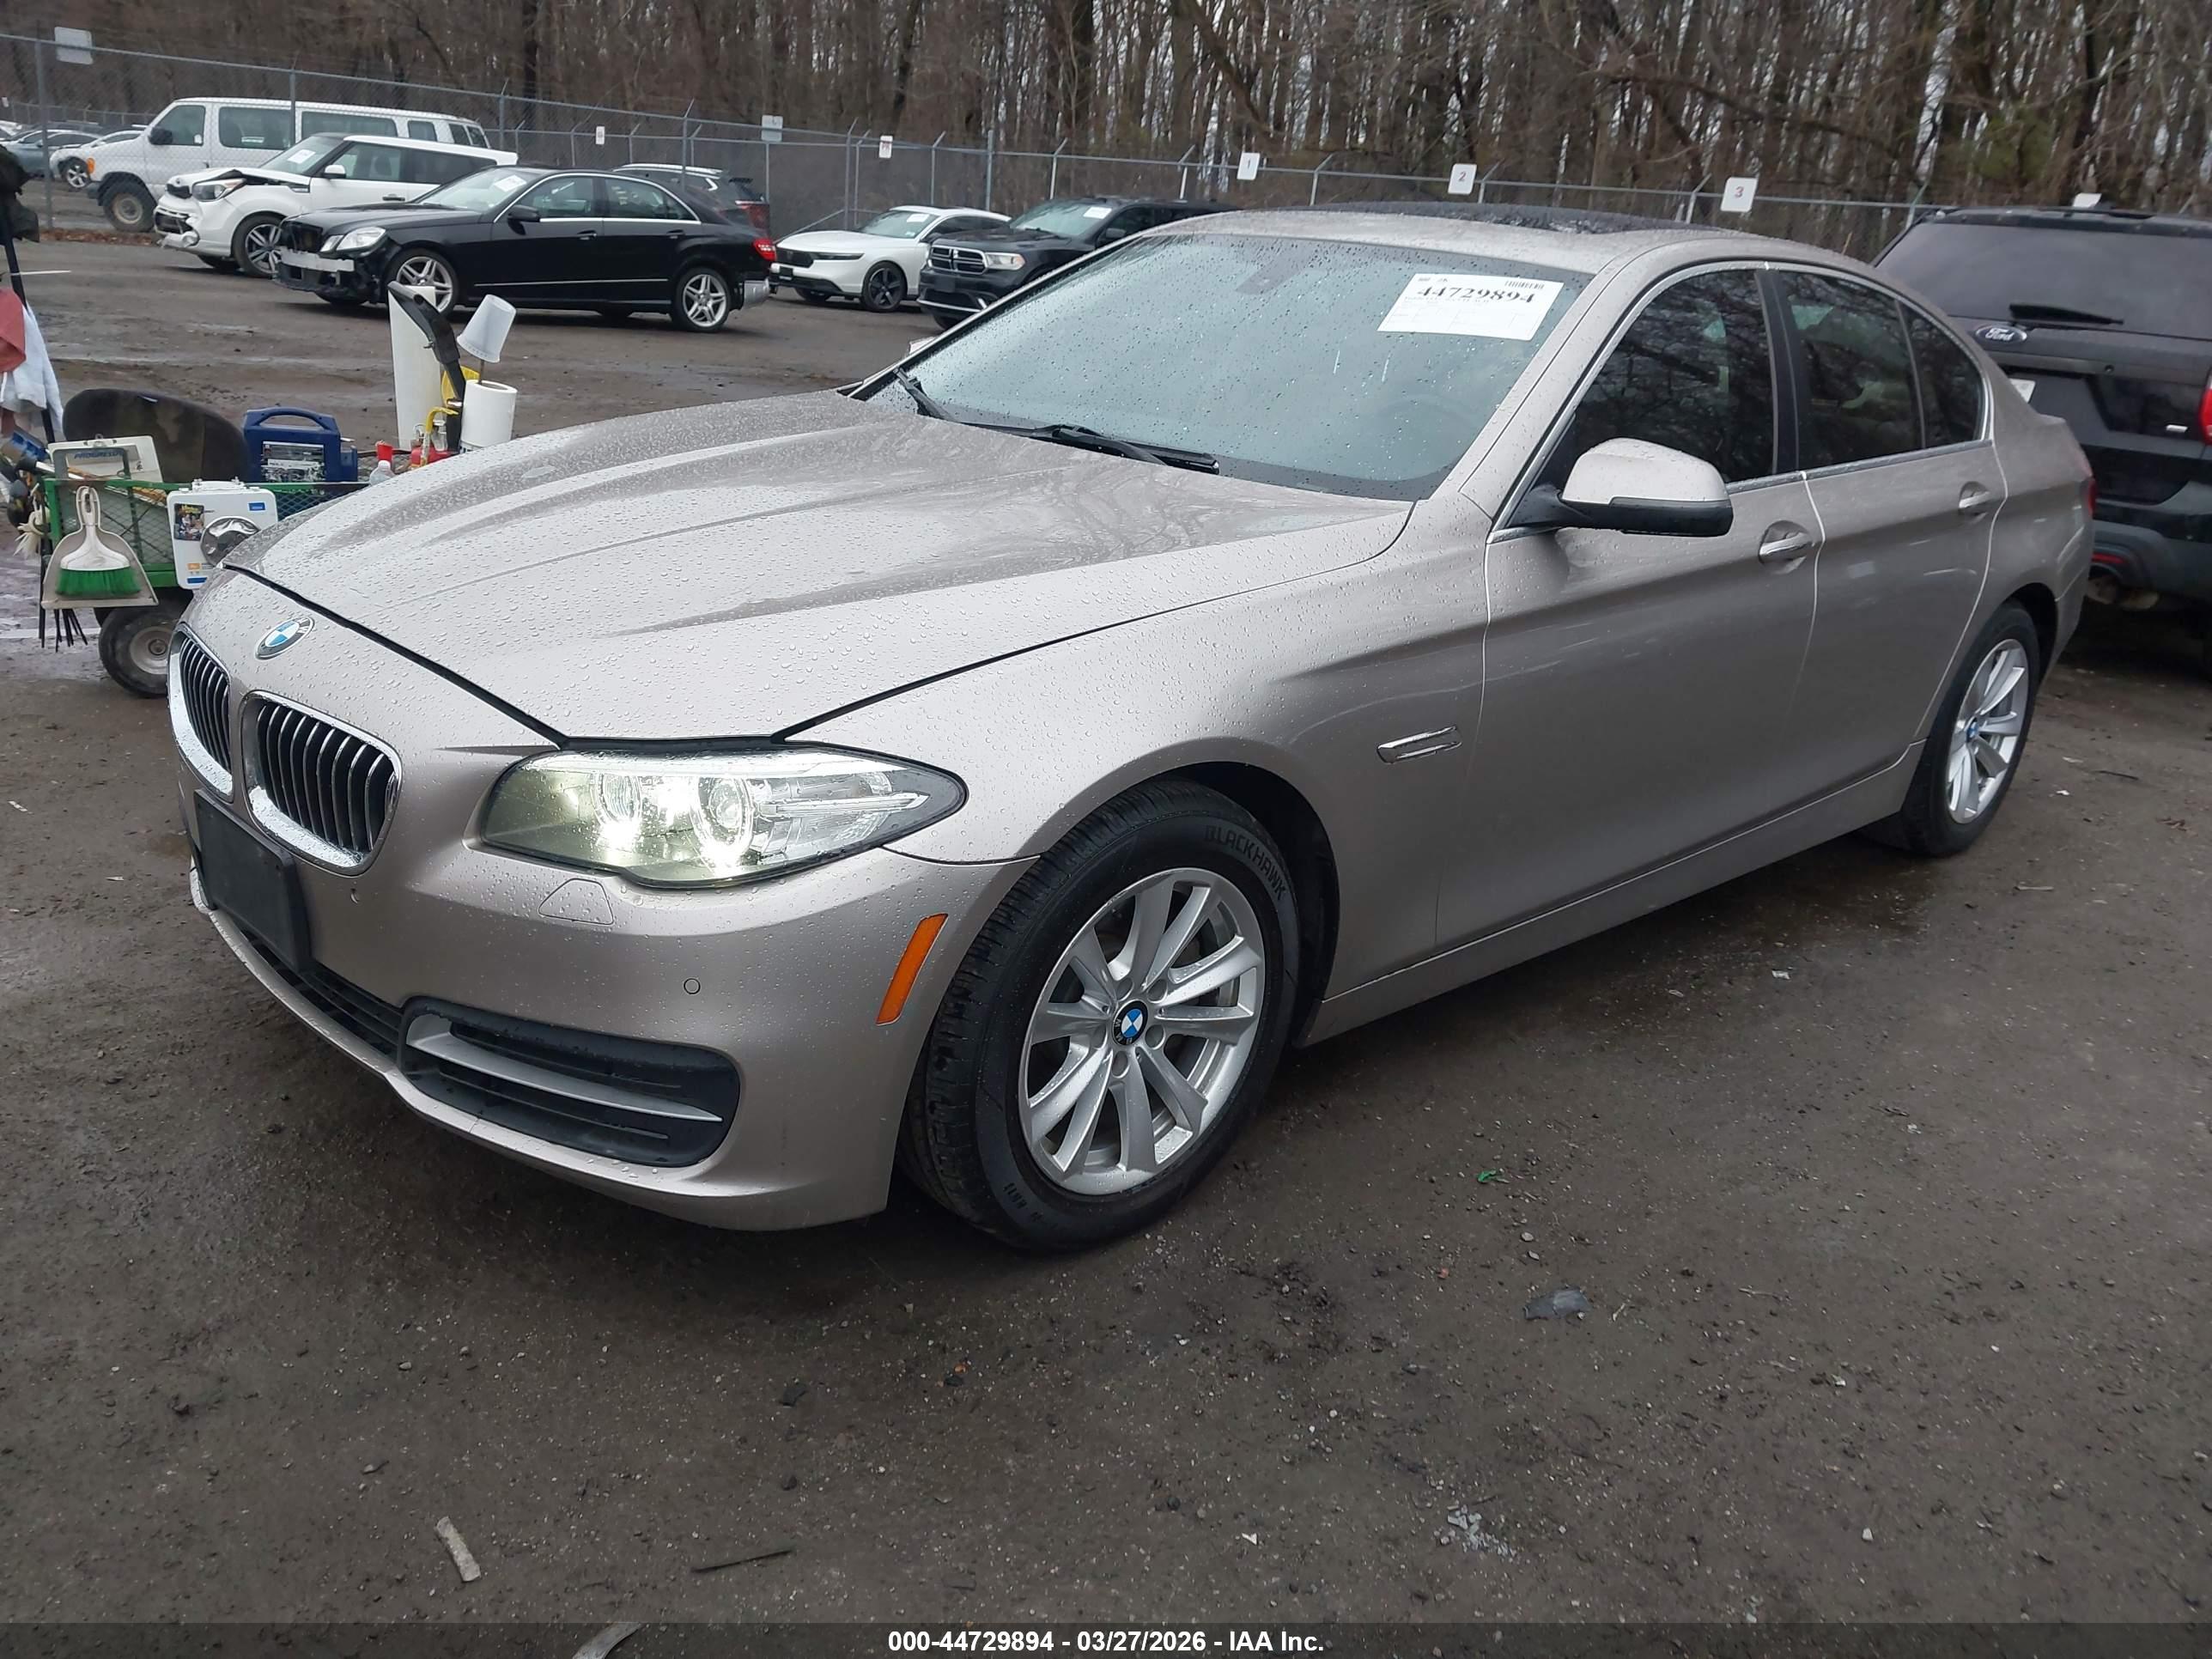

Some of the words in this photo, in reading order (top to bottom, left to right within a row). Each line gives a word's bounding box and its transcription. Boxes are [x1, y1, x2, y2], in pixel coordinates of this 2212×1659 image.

[1459, 171, 1467, 181] 2
[1735, 185, 1744, 198] 3
[1417, 286, 1534, 303] 44729894
[1984, 327, 2015, 341] Ford
[1204, 824, 1286, 902] BLACKHAWK
